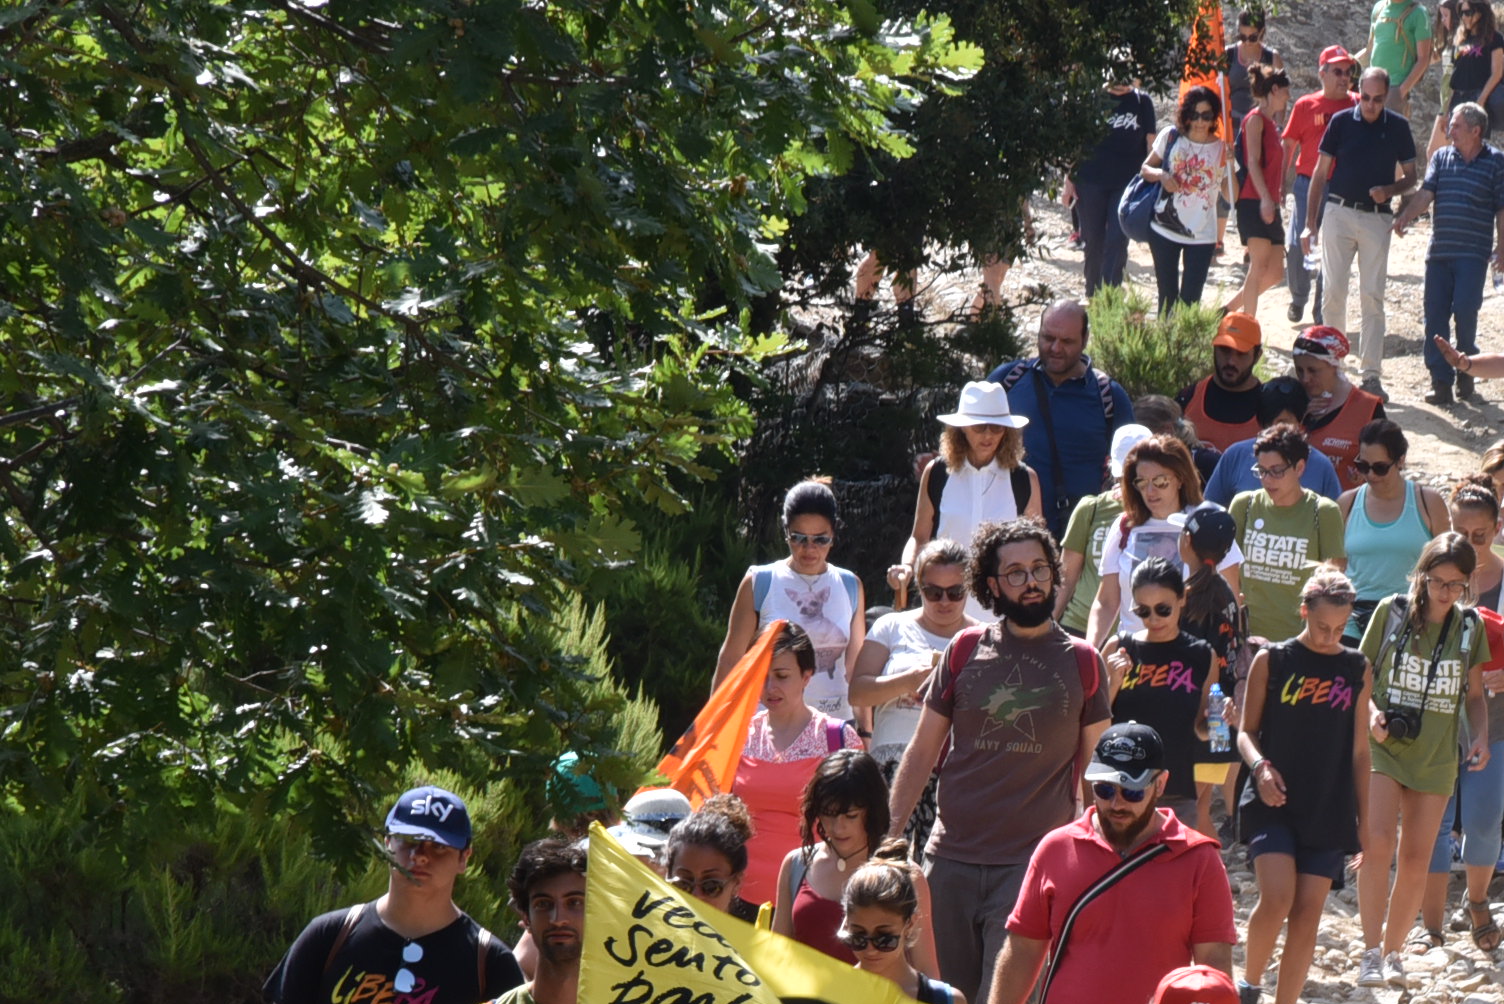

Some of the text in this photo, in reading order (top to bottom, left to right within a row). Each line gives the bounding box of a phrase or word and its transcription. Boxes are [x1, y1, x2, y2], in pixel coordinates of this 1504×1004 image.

[1244, 528, 1309, 554] E!STATE
[1006, 742, 1043, 753] SQUAD
[411, 795, 454, 823] sky
